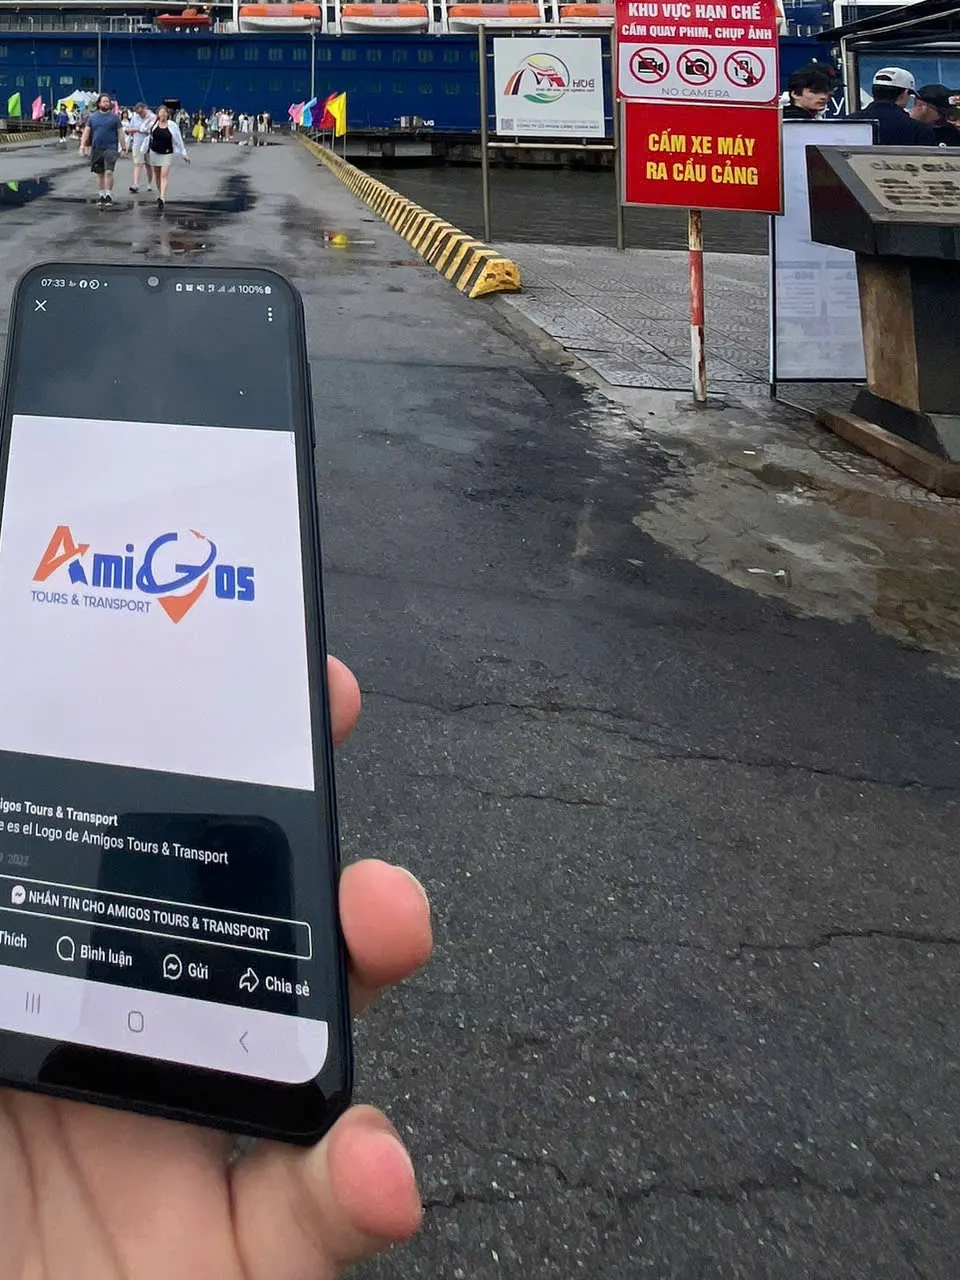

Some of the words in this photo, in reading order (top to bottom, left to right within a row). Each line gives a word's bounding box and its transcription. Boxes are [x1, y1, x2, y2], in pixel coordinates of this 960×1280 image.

[628, 2, 658, 17] KHU
[662, 3, 691, 20] VỰC
[695, 4, 728, 21] HẠN
[731, 1, 761, 20] CHẾ
[621, 22, 647, 36] CẤM
[650, 25, 677, 37] QUAY
[679, 26, 712, 39] PHIM,
[715, 28, 745, 41] CHỤP
[748, 25, 772, 40] ẢNH
[661, 87, 679, 97] NO
[682, 88, 731, 99] CAMERA
[648, 128, 686, 152] CẤM
[690, 135, 713, 154] XE
[717, 134, 756, 156] MÁY
[646, 161, 668, 180] RA
[672, 157, 707, 183] CẦU
[711, 160, 759, 185] CẢNG
[41, 278, 66, 287] 07:33
[238, 285, 264, 294] 100%
[31, 590, 69, 605] TOURS
[71, 595, 80, 606] &
[83, 595, 152, 613] TRANSPORT
[24, 801, 54, 817] Tours
[55, 805, 64, 819] &
[66, 807, 118, 826] Transport
[7, 821, 20, 833] es
[22, 822, 33, 835] el
[35, 823, 63, 841] Logo
[65, 828, 79, 842] de
[81, 830, 124, 849] Amigos
[126, 836, 159, 854] Tours
[161, 841, 170, 856] &
[172, 843, 229, 865] Transport
[28, 889, 60, 907] NHẮN
[62, 895, 80, 910] TIN
[82, 898, 105, 914] CHO
[107, 903, 150, 922] AMIGOS
[153, 910, 190, 928] TOURS
[192, 916, 200, 930] &
[202, 918, 271, 941] TRANSPORT
[80, 944, 106, 961] Bình
[109, 948, 133, 967] luận
[188, 962, 209, 980] Gửi
[265, 976, 292, 994] Chia
[295, 980, 310, 996] sẻ
